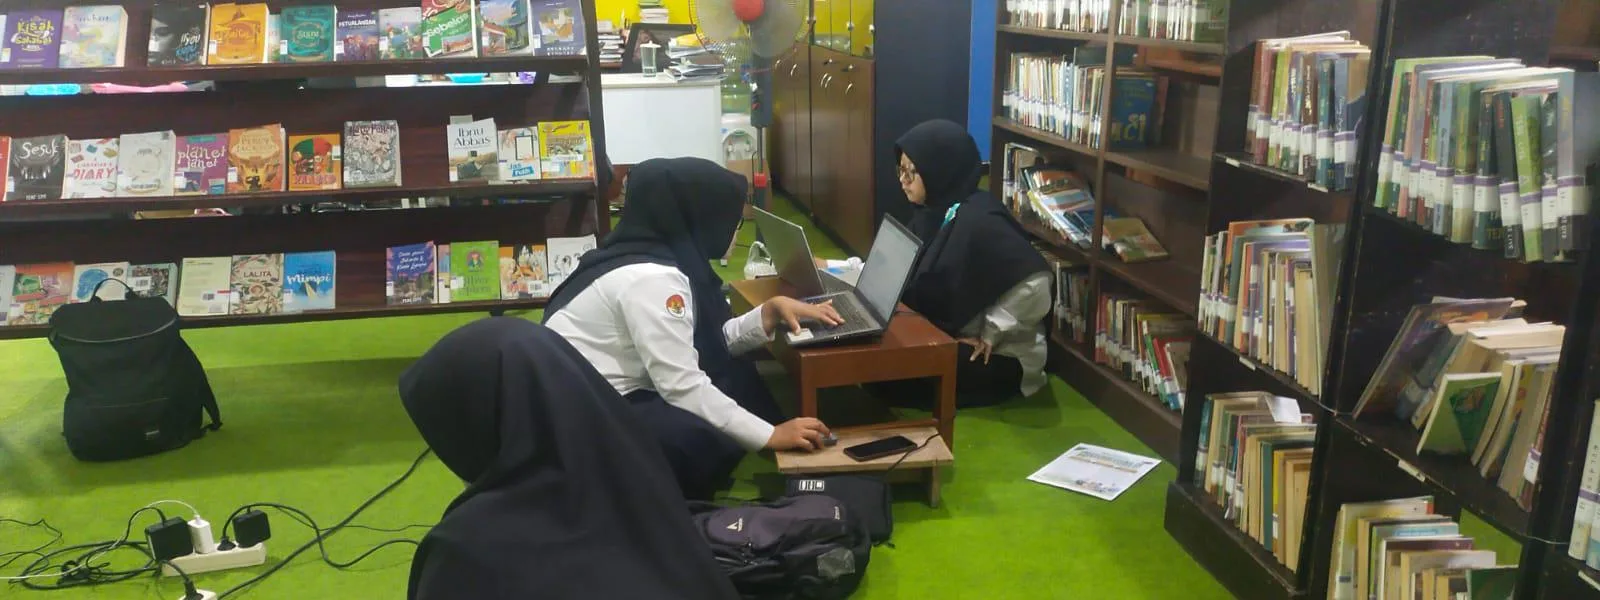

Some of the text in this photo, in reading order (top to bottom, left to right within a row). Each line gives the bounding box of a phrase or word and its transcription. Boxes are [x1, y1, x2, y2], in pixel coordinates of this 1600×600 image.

[458, 127, 484, 137] Ibnu
[453, 137, 491, 147] Abbas
[21, 139, 59, 159] Sesuk
[177, 144, 226, 164] planet
[73, 167, 115, 181] DIARY
[243, 270, 272, 278] LALITA
